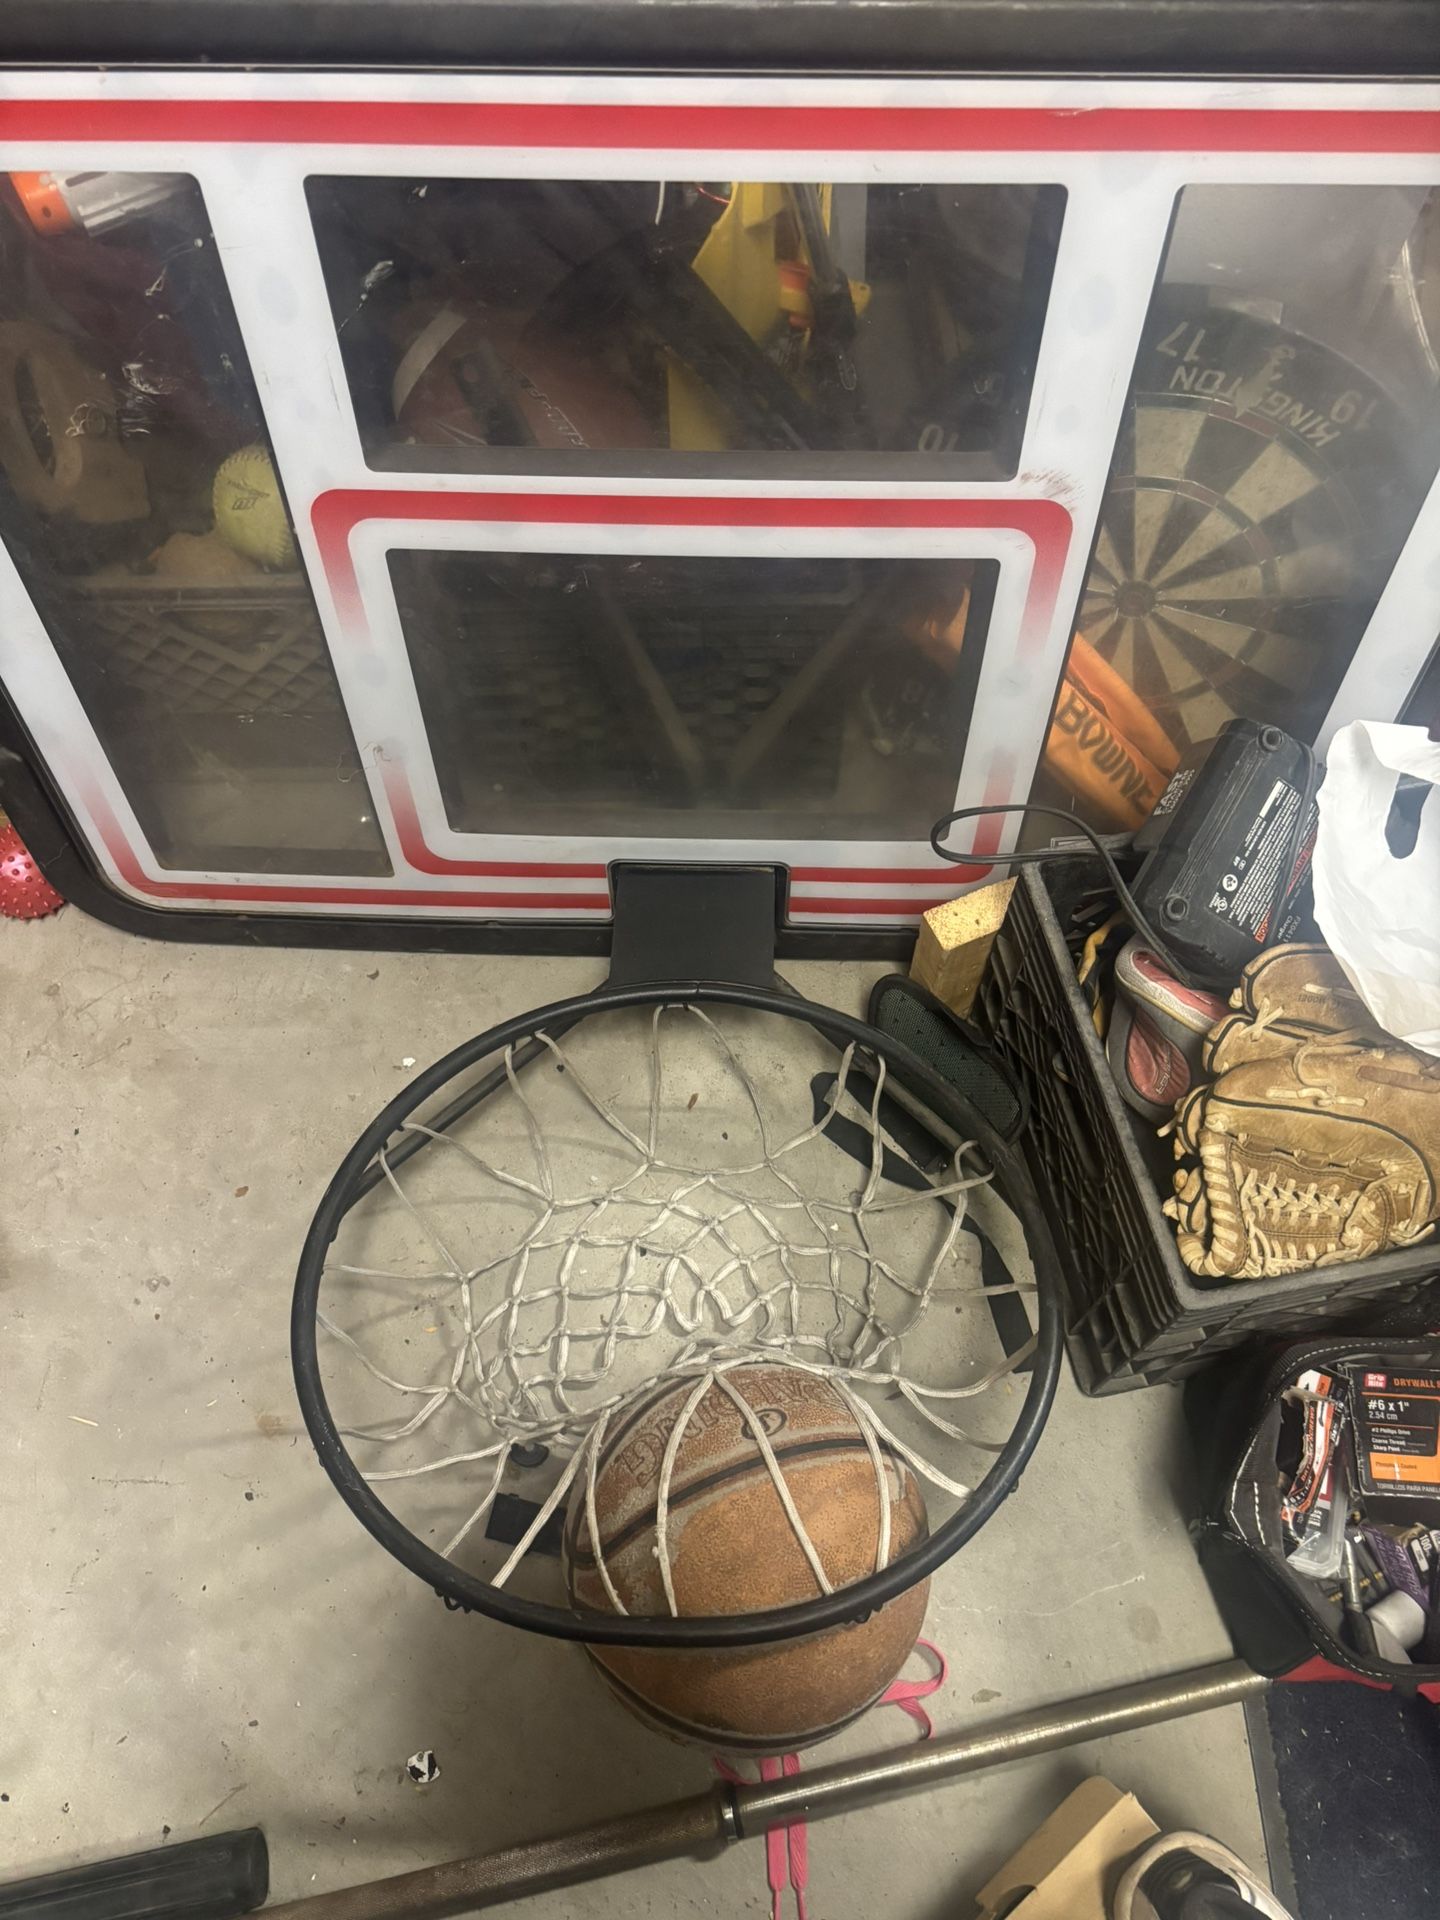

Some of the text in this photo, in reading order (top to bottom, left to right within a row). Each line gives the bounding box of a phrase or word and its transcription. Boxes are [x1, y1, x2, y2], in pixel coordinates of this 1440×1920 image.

[1155, 321, 1206, 362] 17
[1168, 365, 1341, 447] KINGTON
[1277, 915, 1293, 940] Charger
[1393, 1378, 1436, 1388] DRYWALL
[1368, 1399, 1386, 1411] #6
[1388, 1402, 1396, 1412] x
[1368, 1411, 1385, 1420] 2.54
[613, 1379, 850, 1489] PALDING
[1419, 1534, 1433, 1551] 100
